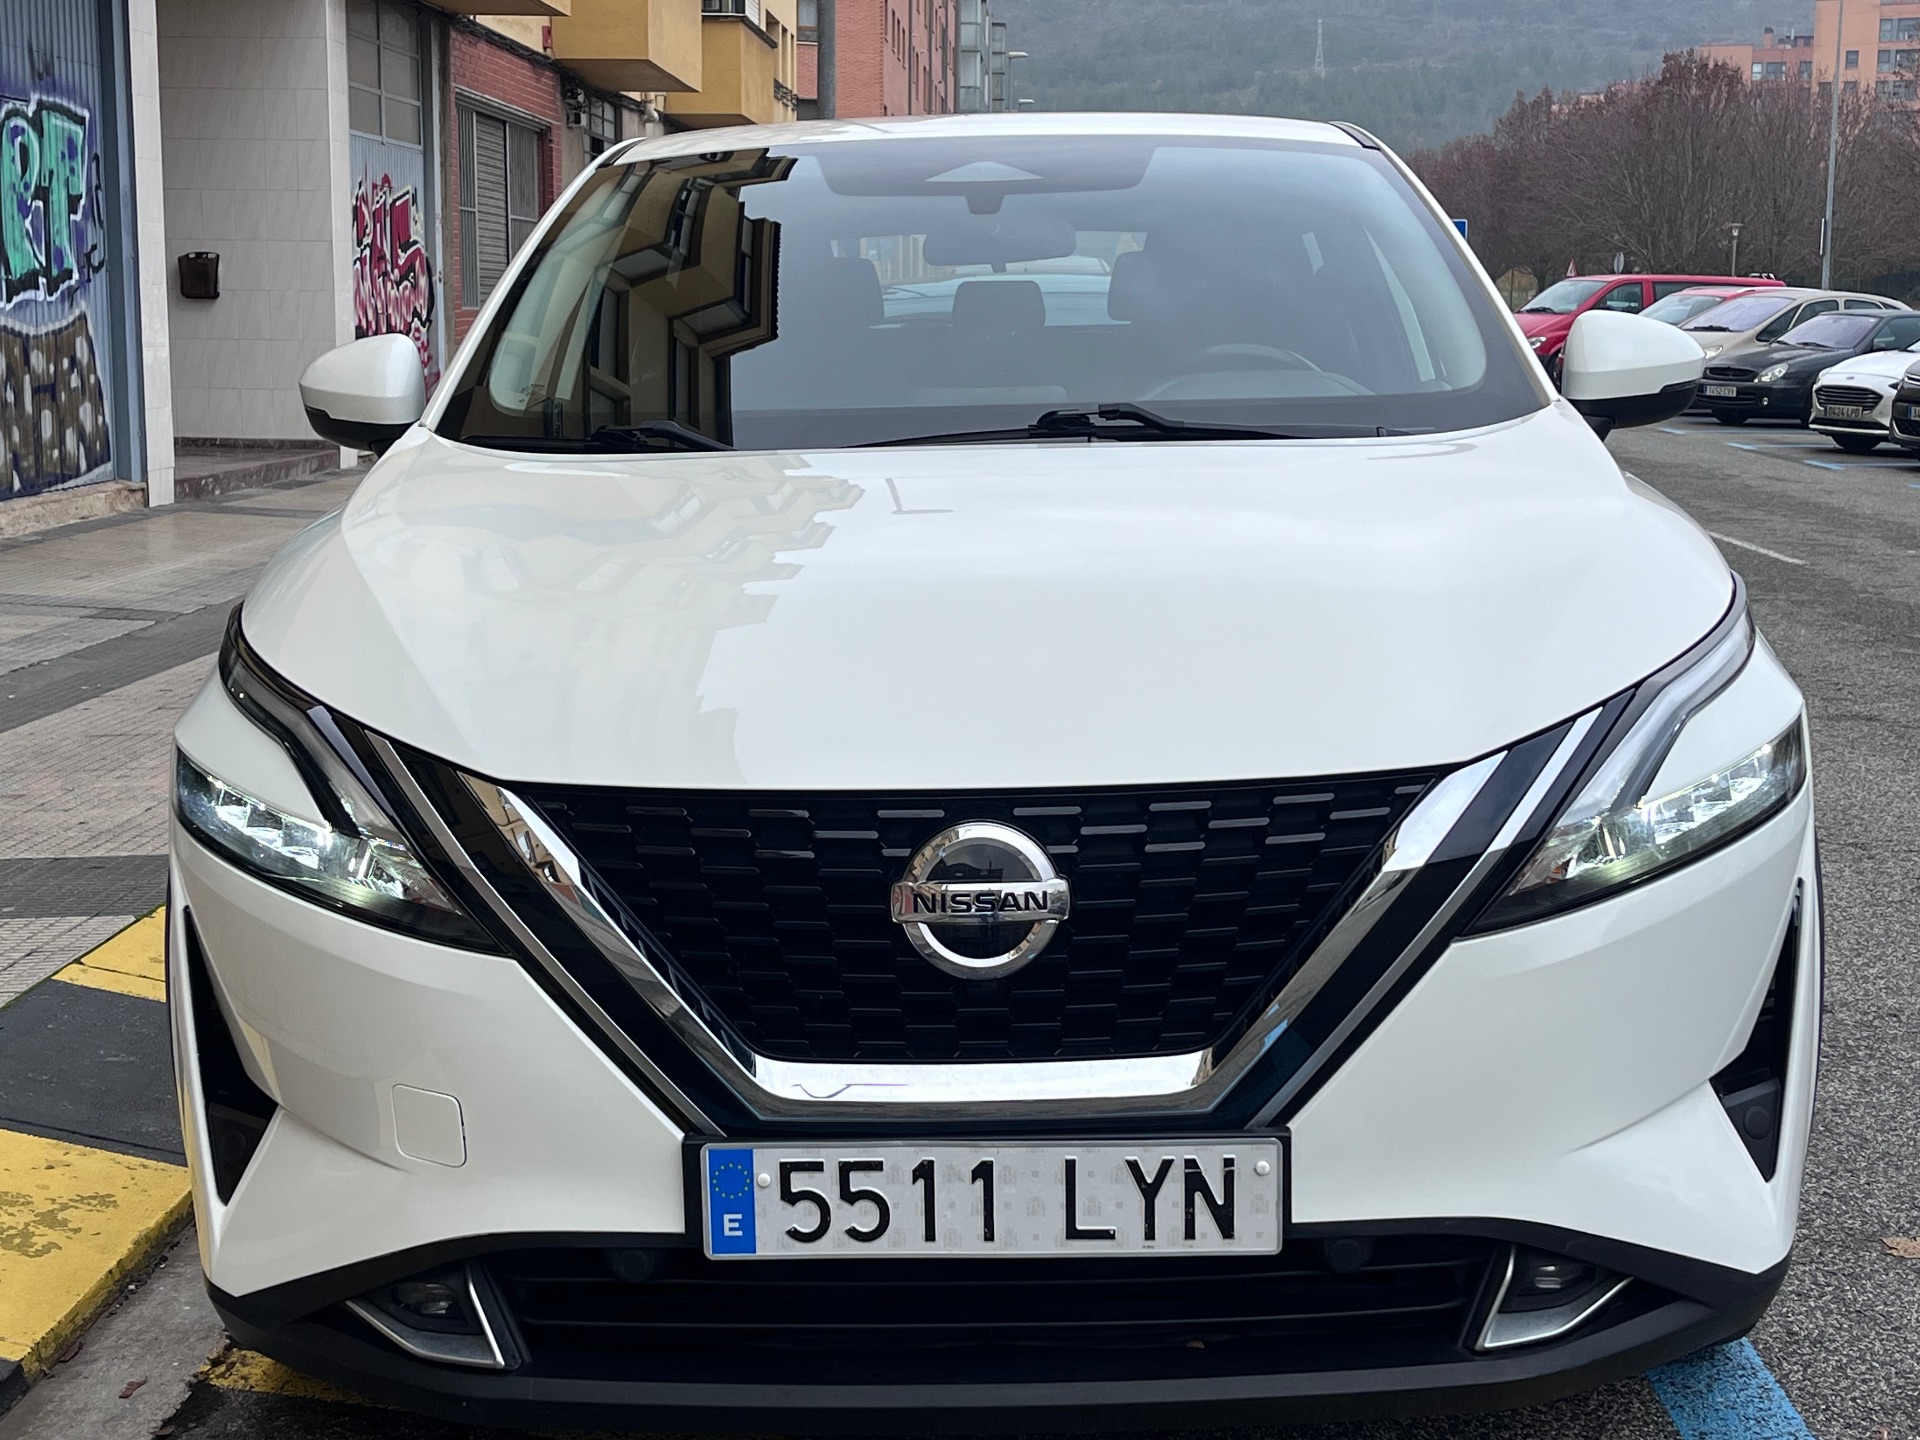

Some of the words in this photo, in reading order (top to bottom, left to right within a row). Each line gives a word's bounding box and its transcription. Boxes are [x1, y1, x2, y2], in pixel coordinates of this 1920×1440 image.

[913, 891, 1048, 913] NISSAN
[779, 1159, 996, 1244] 5511
[1064, 1157, 1235, 1241] LYN
[723, 1213, 743, 1236] E
